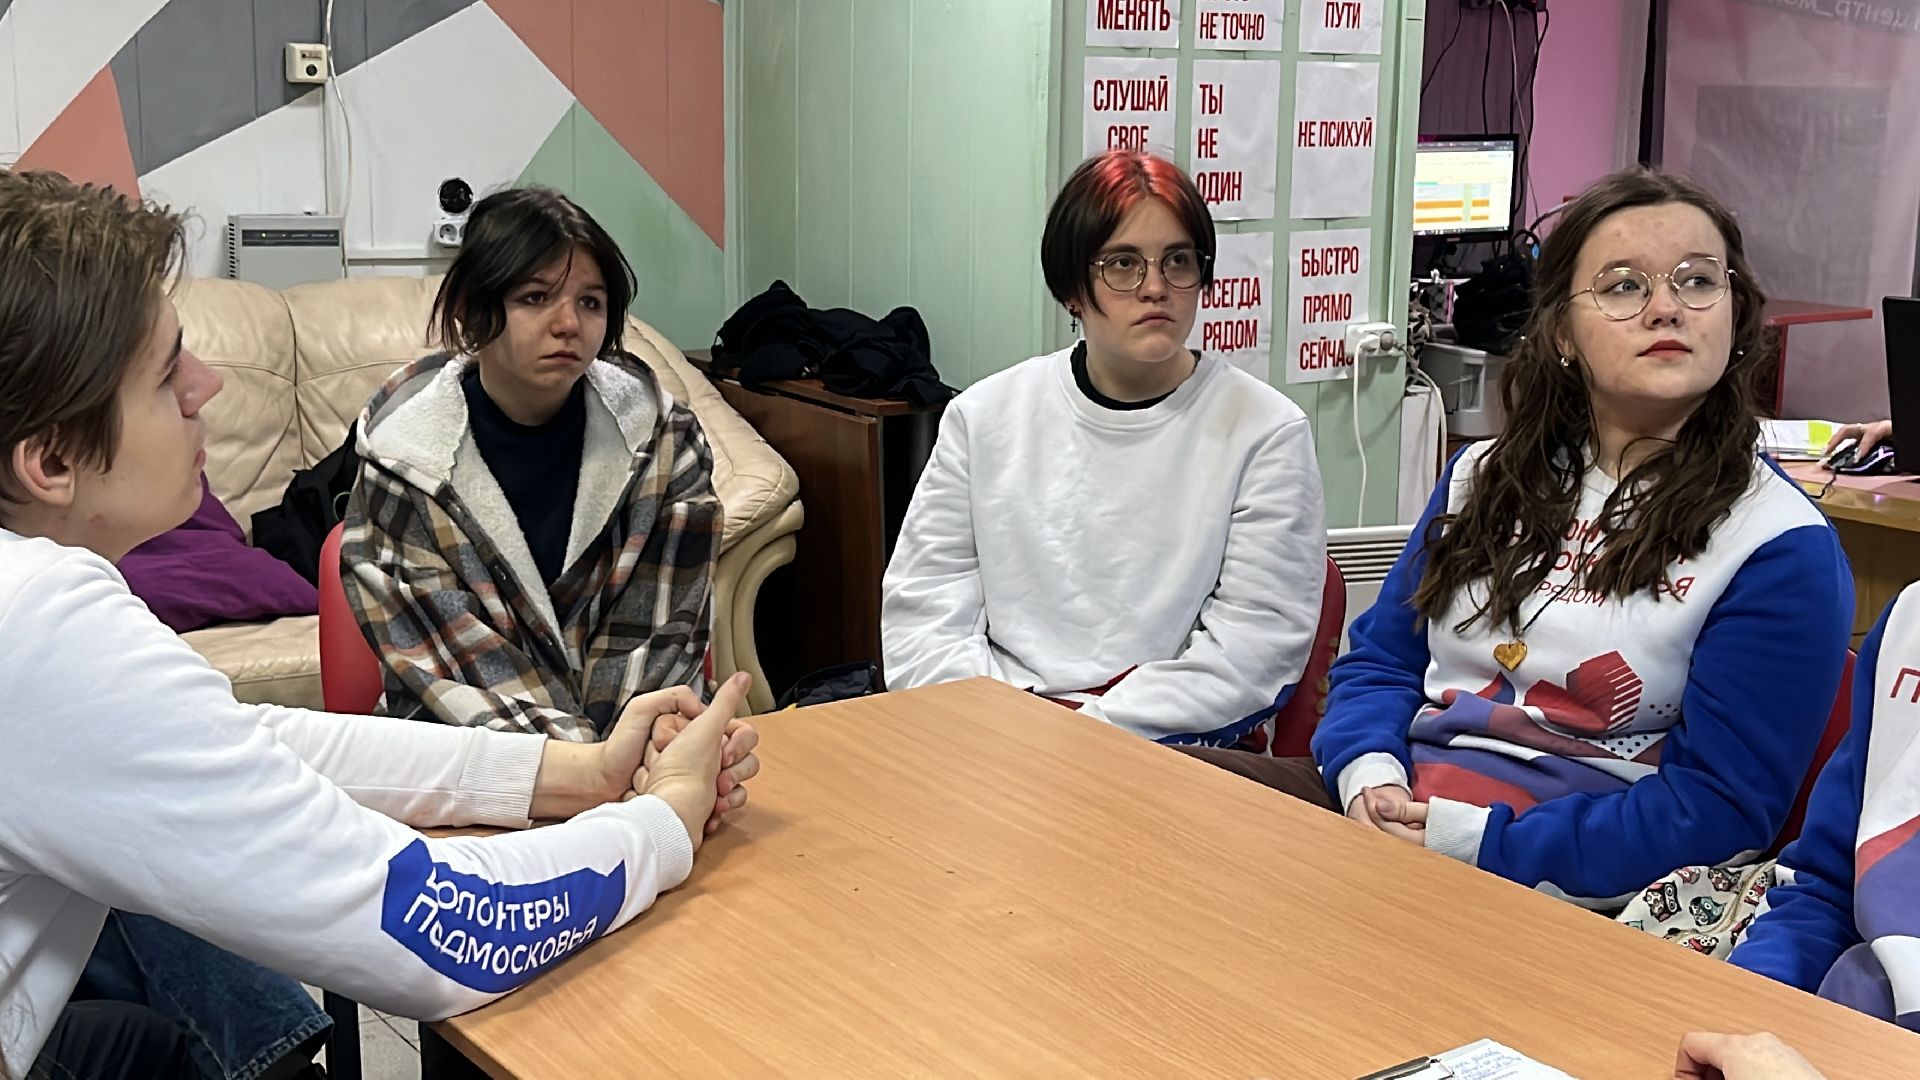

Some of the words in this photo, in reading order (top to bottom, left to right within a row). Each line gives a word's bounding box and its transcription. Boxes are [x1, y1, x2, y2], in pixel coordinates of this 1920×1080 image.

[1097, 0, 1171, 31] МЕНЯТЬ
[1199, 12, 1218, 39] НЕ
[1221, 13, 1265, 40] ТОЧНО
[1325, 2, 1361, 29] ПУТИ
[1093, 75, 1169, 112] СЛУШАЙ
[1199, 84, 1223, 115] ТЫ
[1107, 125, 1150, 153] СВОЕ
[1197, 128, 1219, 159] НЕ
[1298, 121, 1317, 147] НЕ
[1319, 117, 1373, 148] ПСИХУЙ
[1196, 171, 1243, 206] ОДИН
[1301, 246, 1359, 277] БЫСТРО
[1201, 277, 1262, 310] ВСЕГДА
[1303, 293, 1352, 324] ПРЯМО
[1202, 319, 1258, 353] РЯДОМ
[1534, 579, 1608, 608] РЯДОМ
[426, 866, 571, 931] ОЛОНТЕРЫ
[403, 892, 598, 975] ПОДМОСКОВЬЯ
